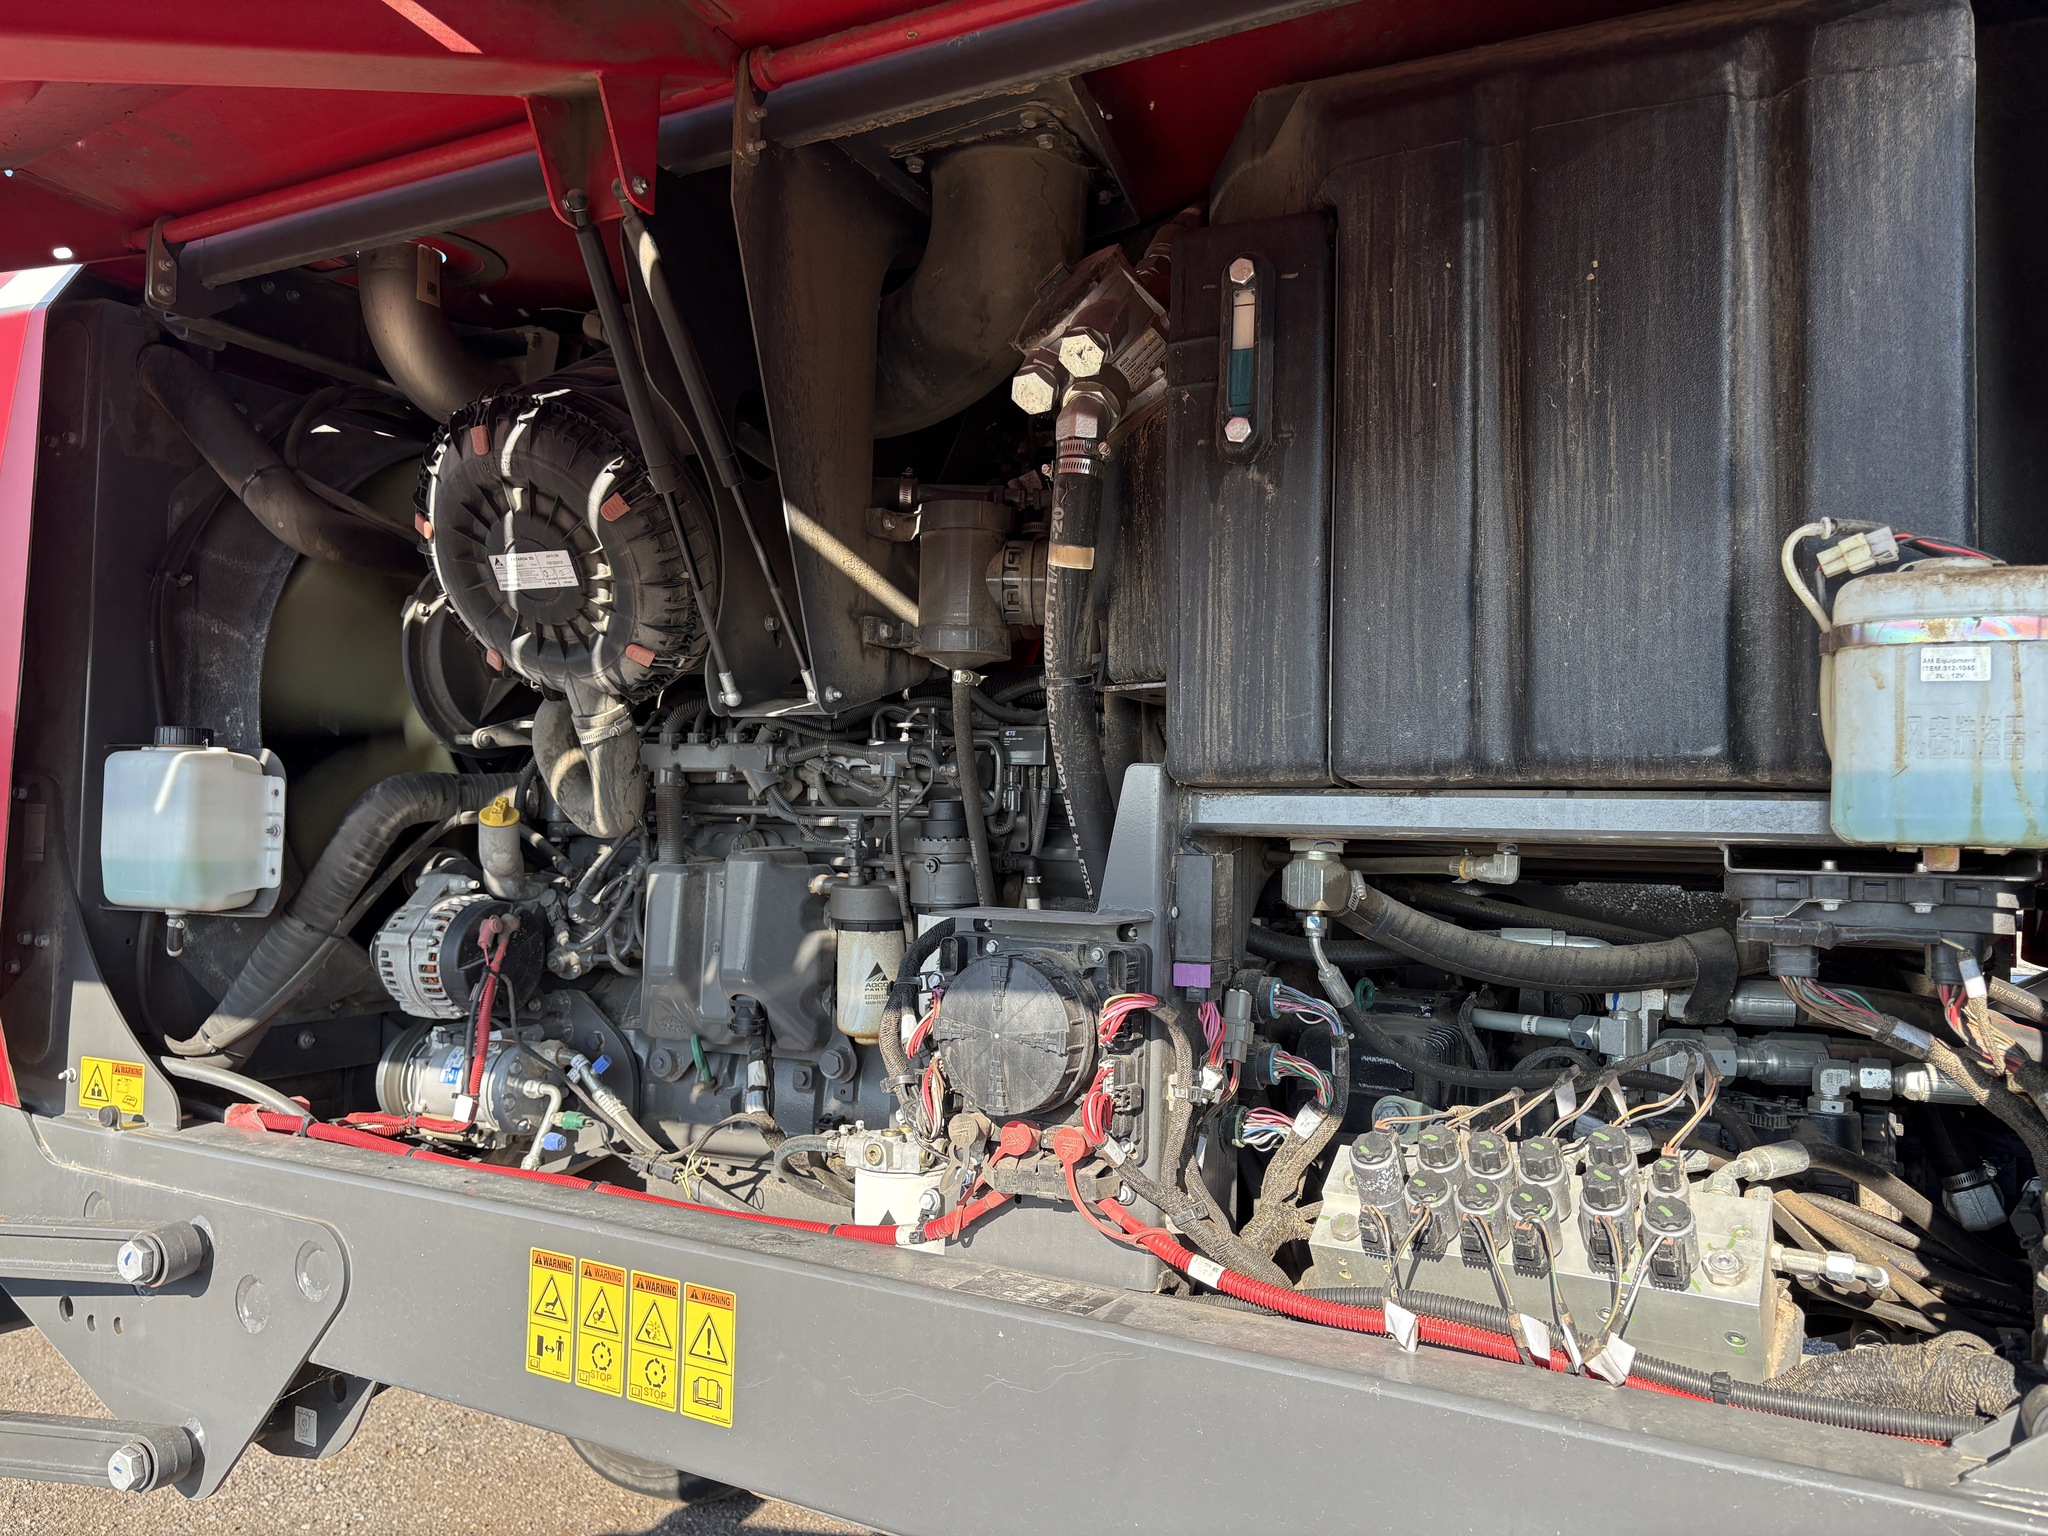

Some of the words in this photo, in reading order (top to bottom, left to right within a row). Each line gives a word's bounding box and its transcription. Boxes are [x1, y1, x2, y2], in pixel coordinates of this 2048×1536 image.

[1063, 796, 1076, 827] bar
[120, 1066, 142, 1077] WARNING
[543, 1255, 572, 1272] WARNING
[594, 1267, 622, 1283] WARNING
[644, 1279, 677, 1297] WARNING
[701, 1290, 731, 1307] WARNING
[590, 1369, 612, 1383] STOP
[643, 1387, 667, 1400] STOP
